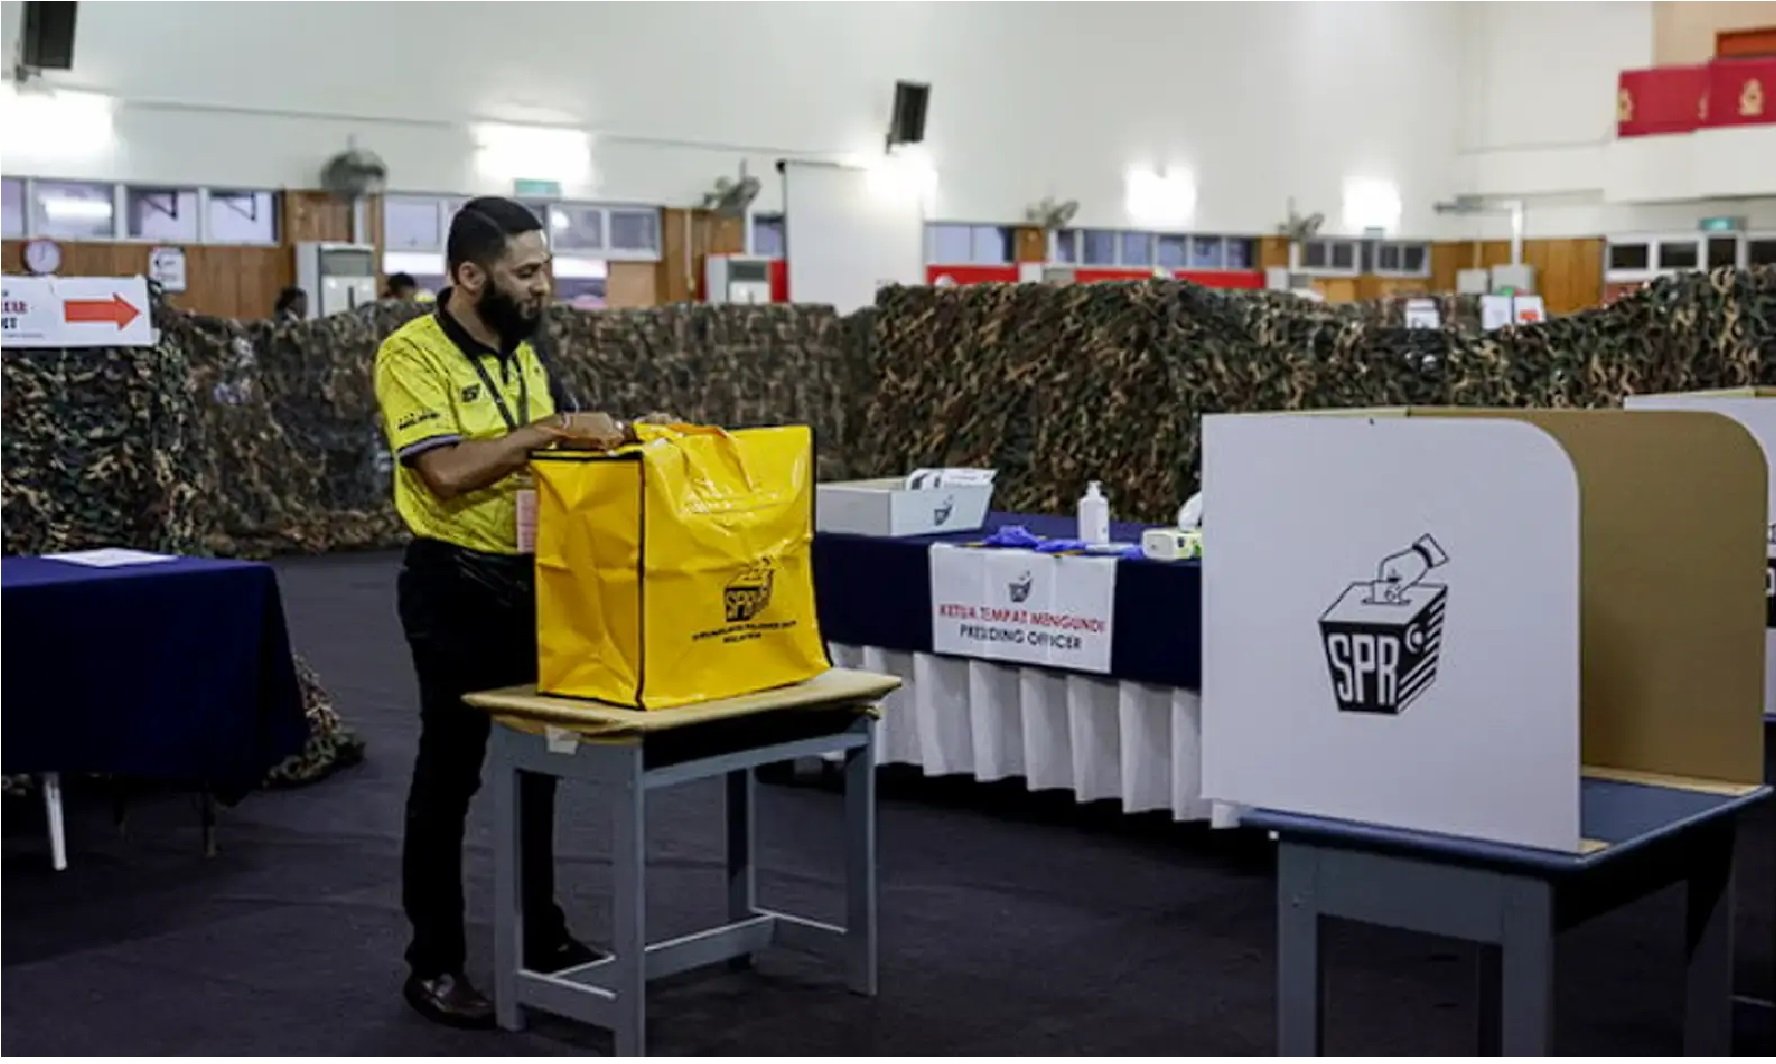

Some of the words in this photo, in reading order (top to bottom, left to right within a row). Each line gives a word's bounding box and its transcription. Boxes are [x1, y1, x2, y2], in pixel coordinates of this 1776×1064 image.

[980, 606, 1028, 624] TEMPAT
[1030, 611, 1106, 633] MENGUNDI
[960, 623, 1025, 644] PRESIDING
[1027, 630, 1082, 650] OFFICER
[1328, 633, 1400, 705] SPR
